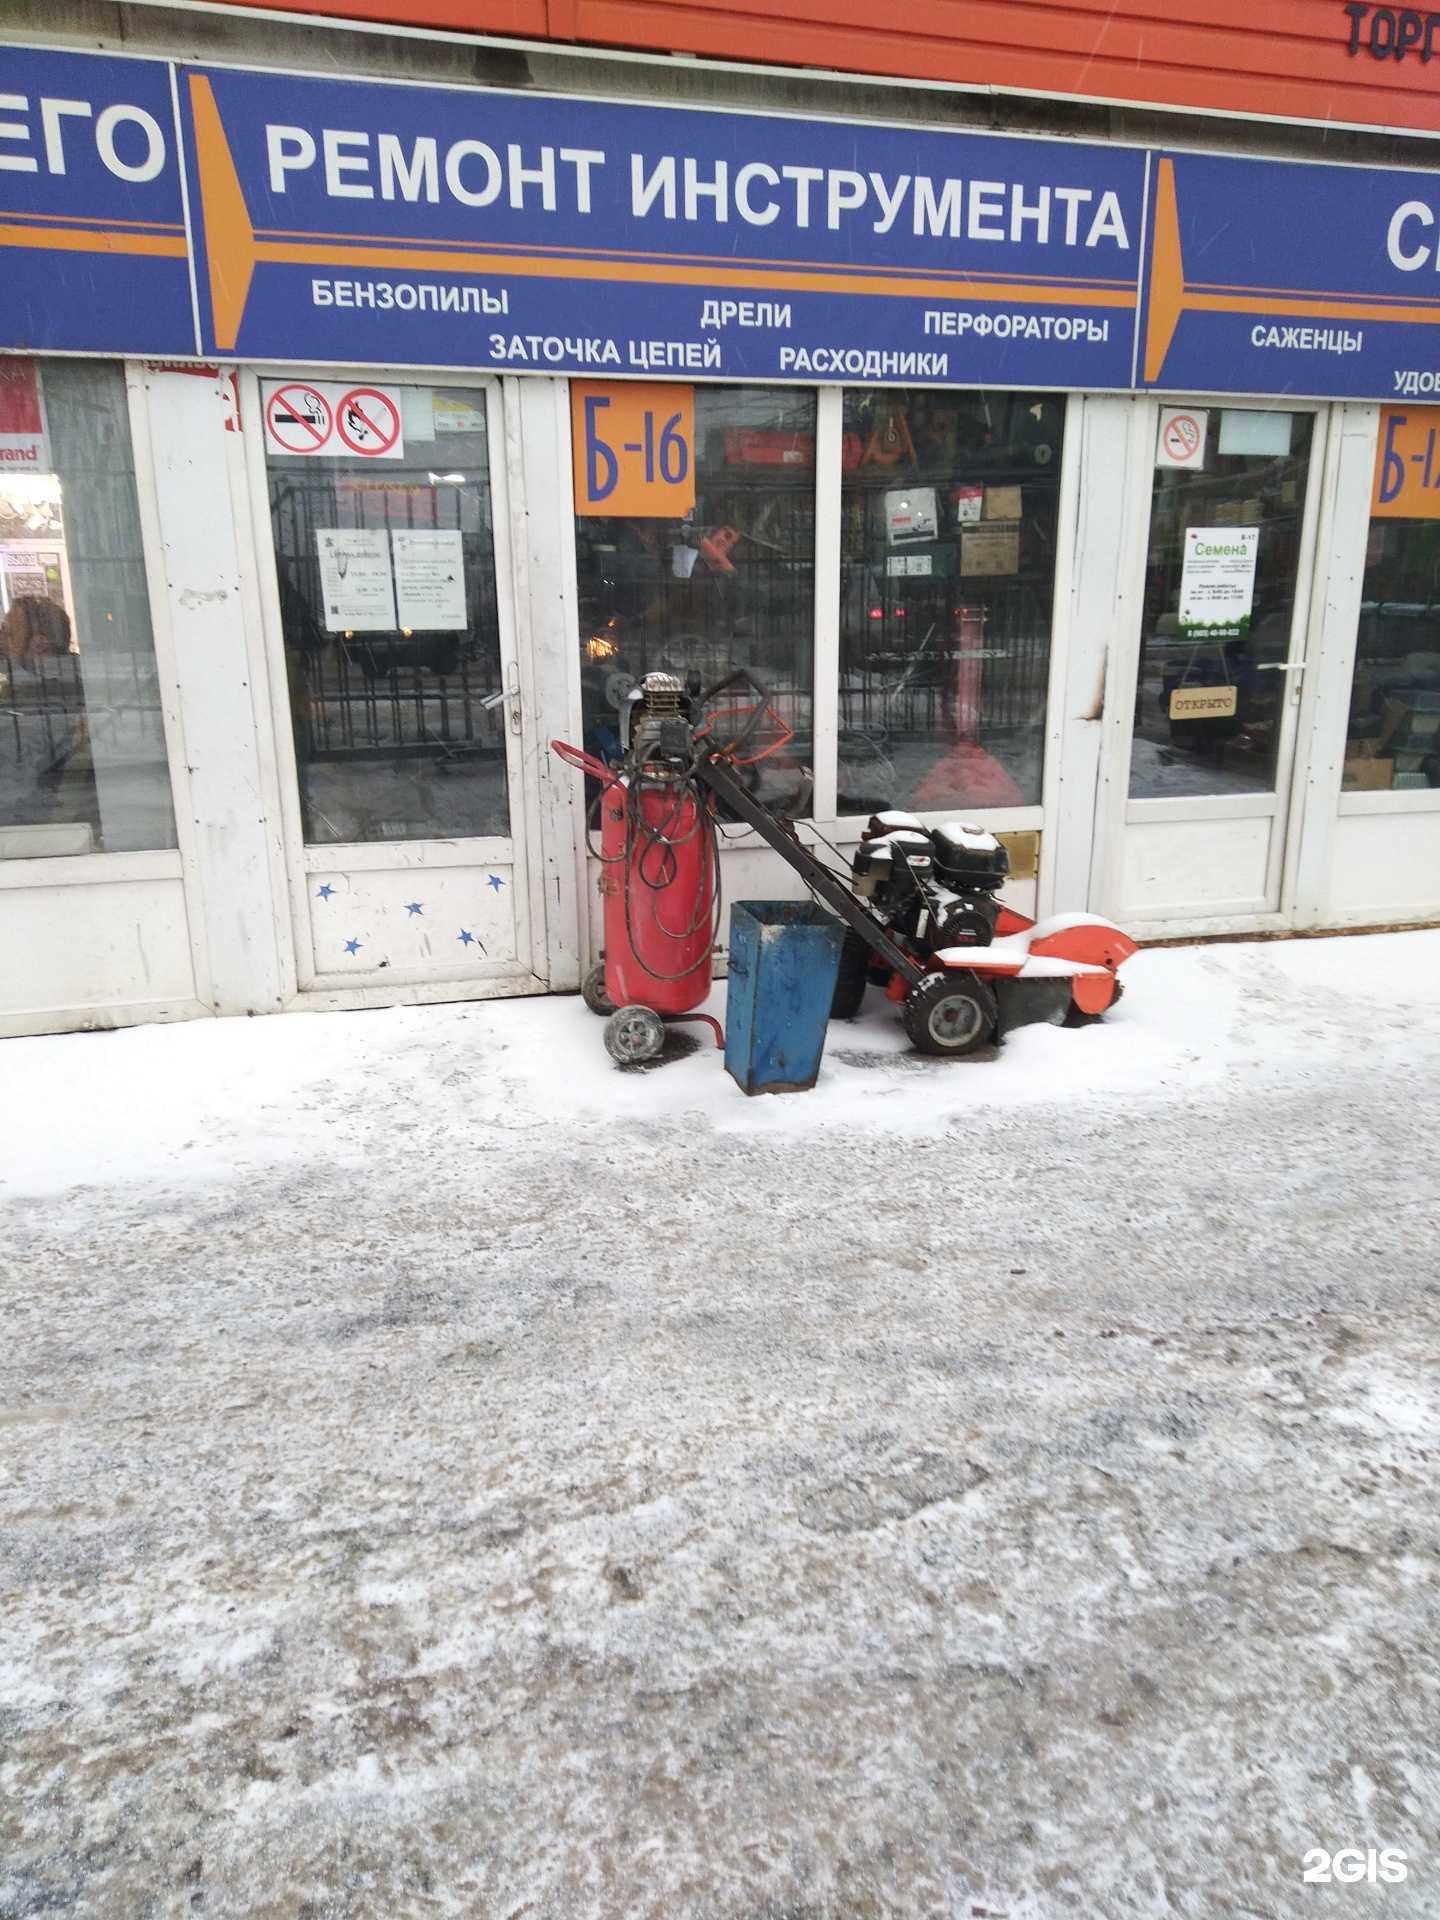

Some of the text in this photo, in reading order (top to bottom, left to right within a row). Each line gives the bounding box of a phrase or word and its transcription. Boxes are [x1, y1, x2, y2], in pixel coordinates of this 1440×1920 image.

[265, 123, 1129, 250] РЕМОНТ ИНСТРУМЕНТА
[1386, 200, 1440, 272] С
[311, 280, 509, 315] БЕНЗОПИЛЫ
[700, 300, 792, 329] ДРЕЛИ
[924, 310, 1109, 343] ПЕРФОРАТОРЫ
[1251, 324, 1363, 354] САЖЕНЦЫ
[489, 334, 721, 370] ЗАТОЧКА ЦЕПЕЙ
[779, 346, 948, 377] РАСХОДНИКИ
[585, 396, 688, 502] Б-16
[1379, 416, 1440, 503] Б-1
[1194, 543, 1248, 556] Семена
[1175, 697, 1233, 711] ОТКРЫТО
